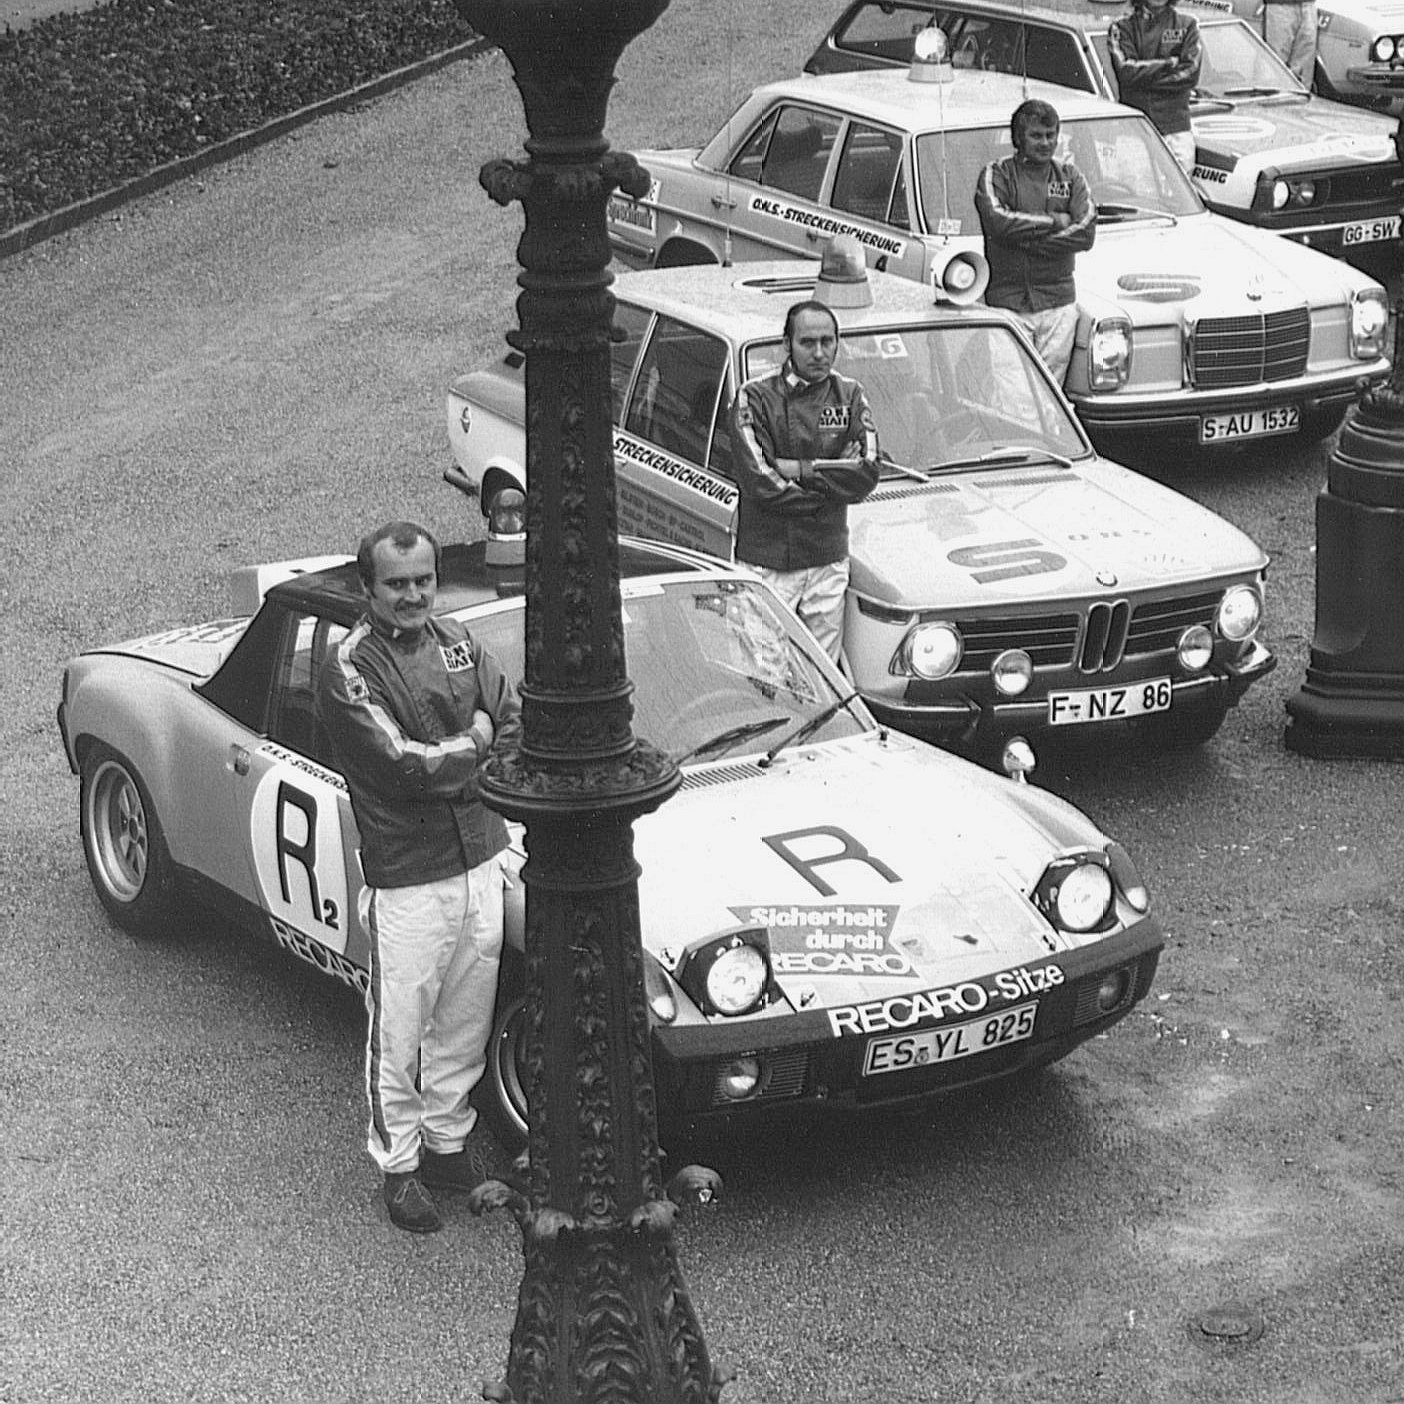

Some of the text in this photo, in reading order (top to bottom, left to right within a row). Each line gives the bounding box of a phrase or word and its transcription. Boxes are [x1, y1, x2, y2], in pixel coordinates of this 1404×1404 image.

[1192, 167, 1227, 184] RUNG
[1345, 220, 1396, 243] GG-SW
[1203, 407, 1299, 440] S-AU 1532
[1051, 682, 1170, 723] F-NZ 86
[276, 780, 324, 924] R
[760, 825, 903, 897] R
[323, 898, 340, 931] 2
[750, 906, 888, 927] Sicherheit
[806, 928, 883, 950] durch
[981, 1007, 1033, 1045] 825
